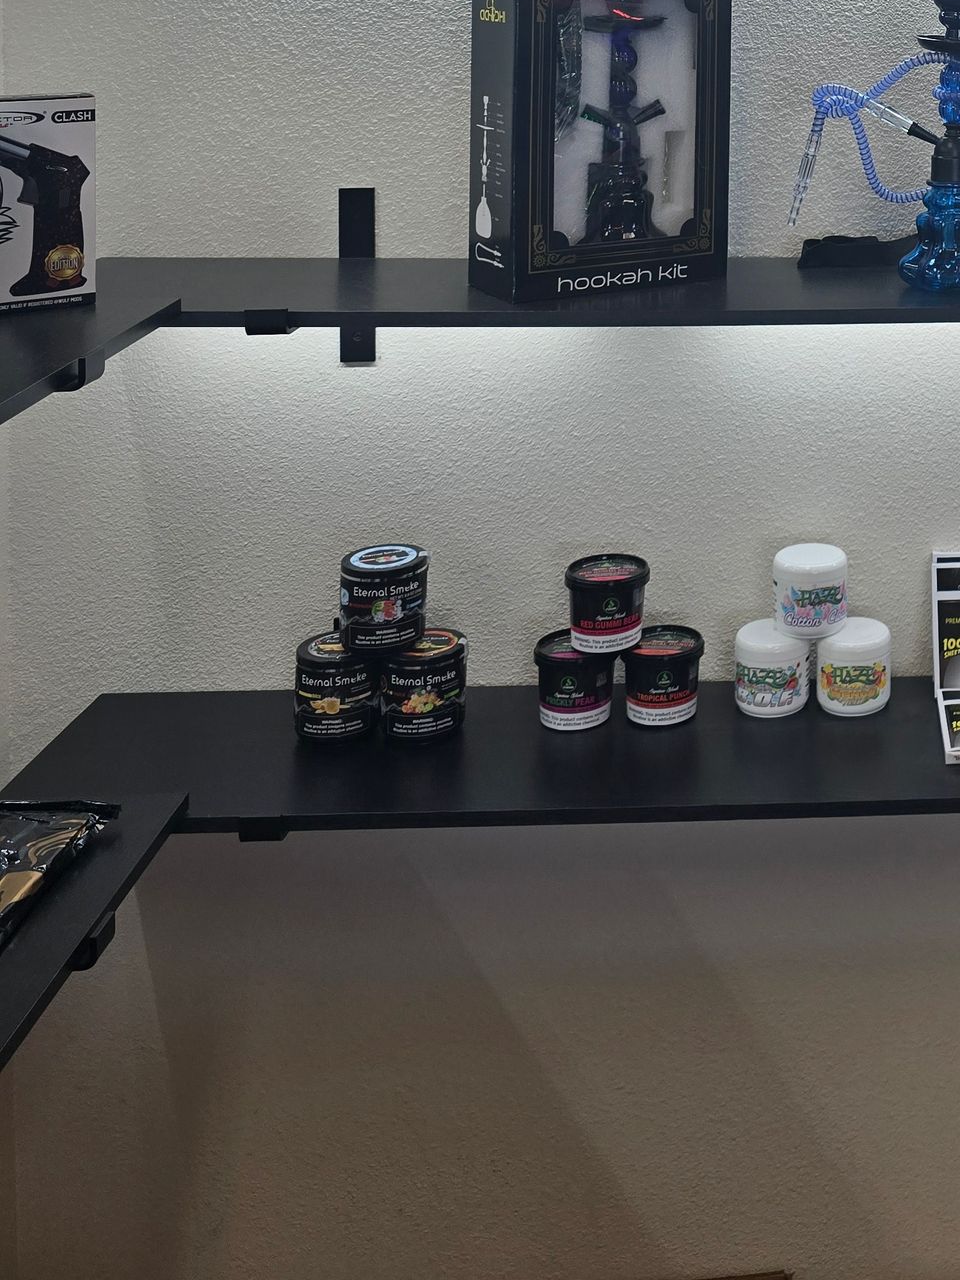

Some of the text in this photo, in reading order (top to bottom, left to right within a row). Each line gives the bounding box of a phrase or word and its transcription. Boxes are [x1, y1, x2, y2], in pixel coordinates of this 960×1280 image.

[54, 111, 92, 122] CLASH
[557, 263, 689, 293] hookah kit
[353, 586, 388, 598] Eternal
[389, 581, 419, 596] Smoke
[580, 620, 593, 629] RED
[594, 619, 622, 629] GUMMI
[784, 611, 822, 628] Cotton
[301, 672, 367, 687] Eternal Smoke
[391, 670, 456, 686] Eternal Smoke
[575, 696, 595, 706] PEAR
[637, 692, 669, 702] TROPICAL
